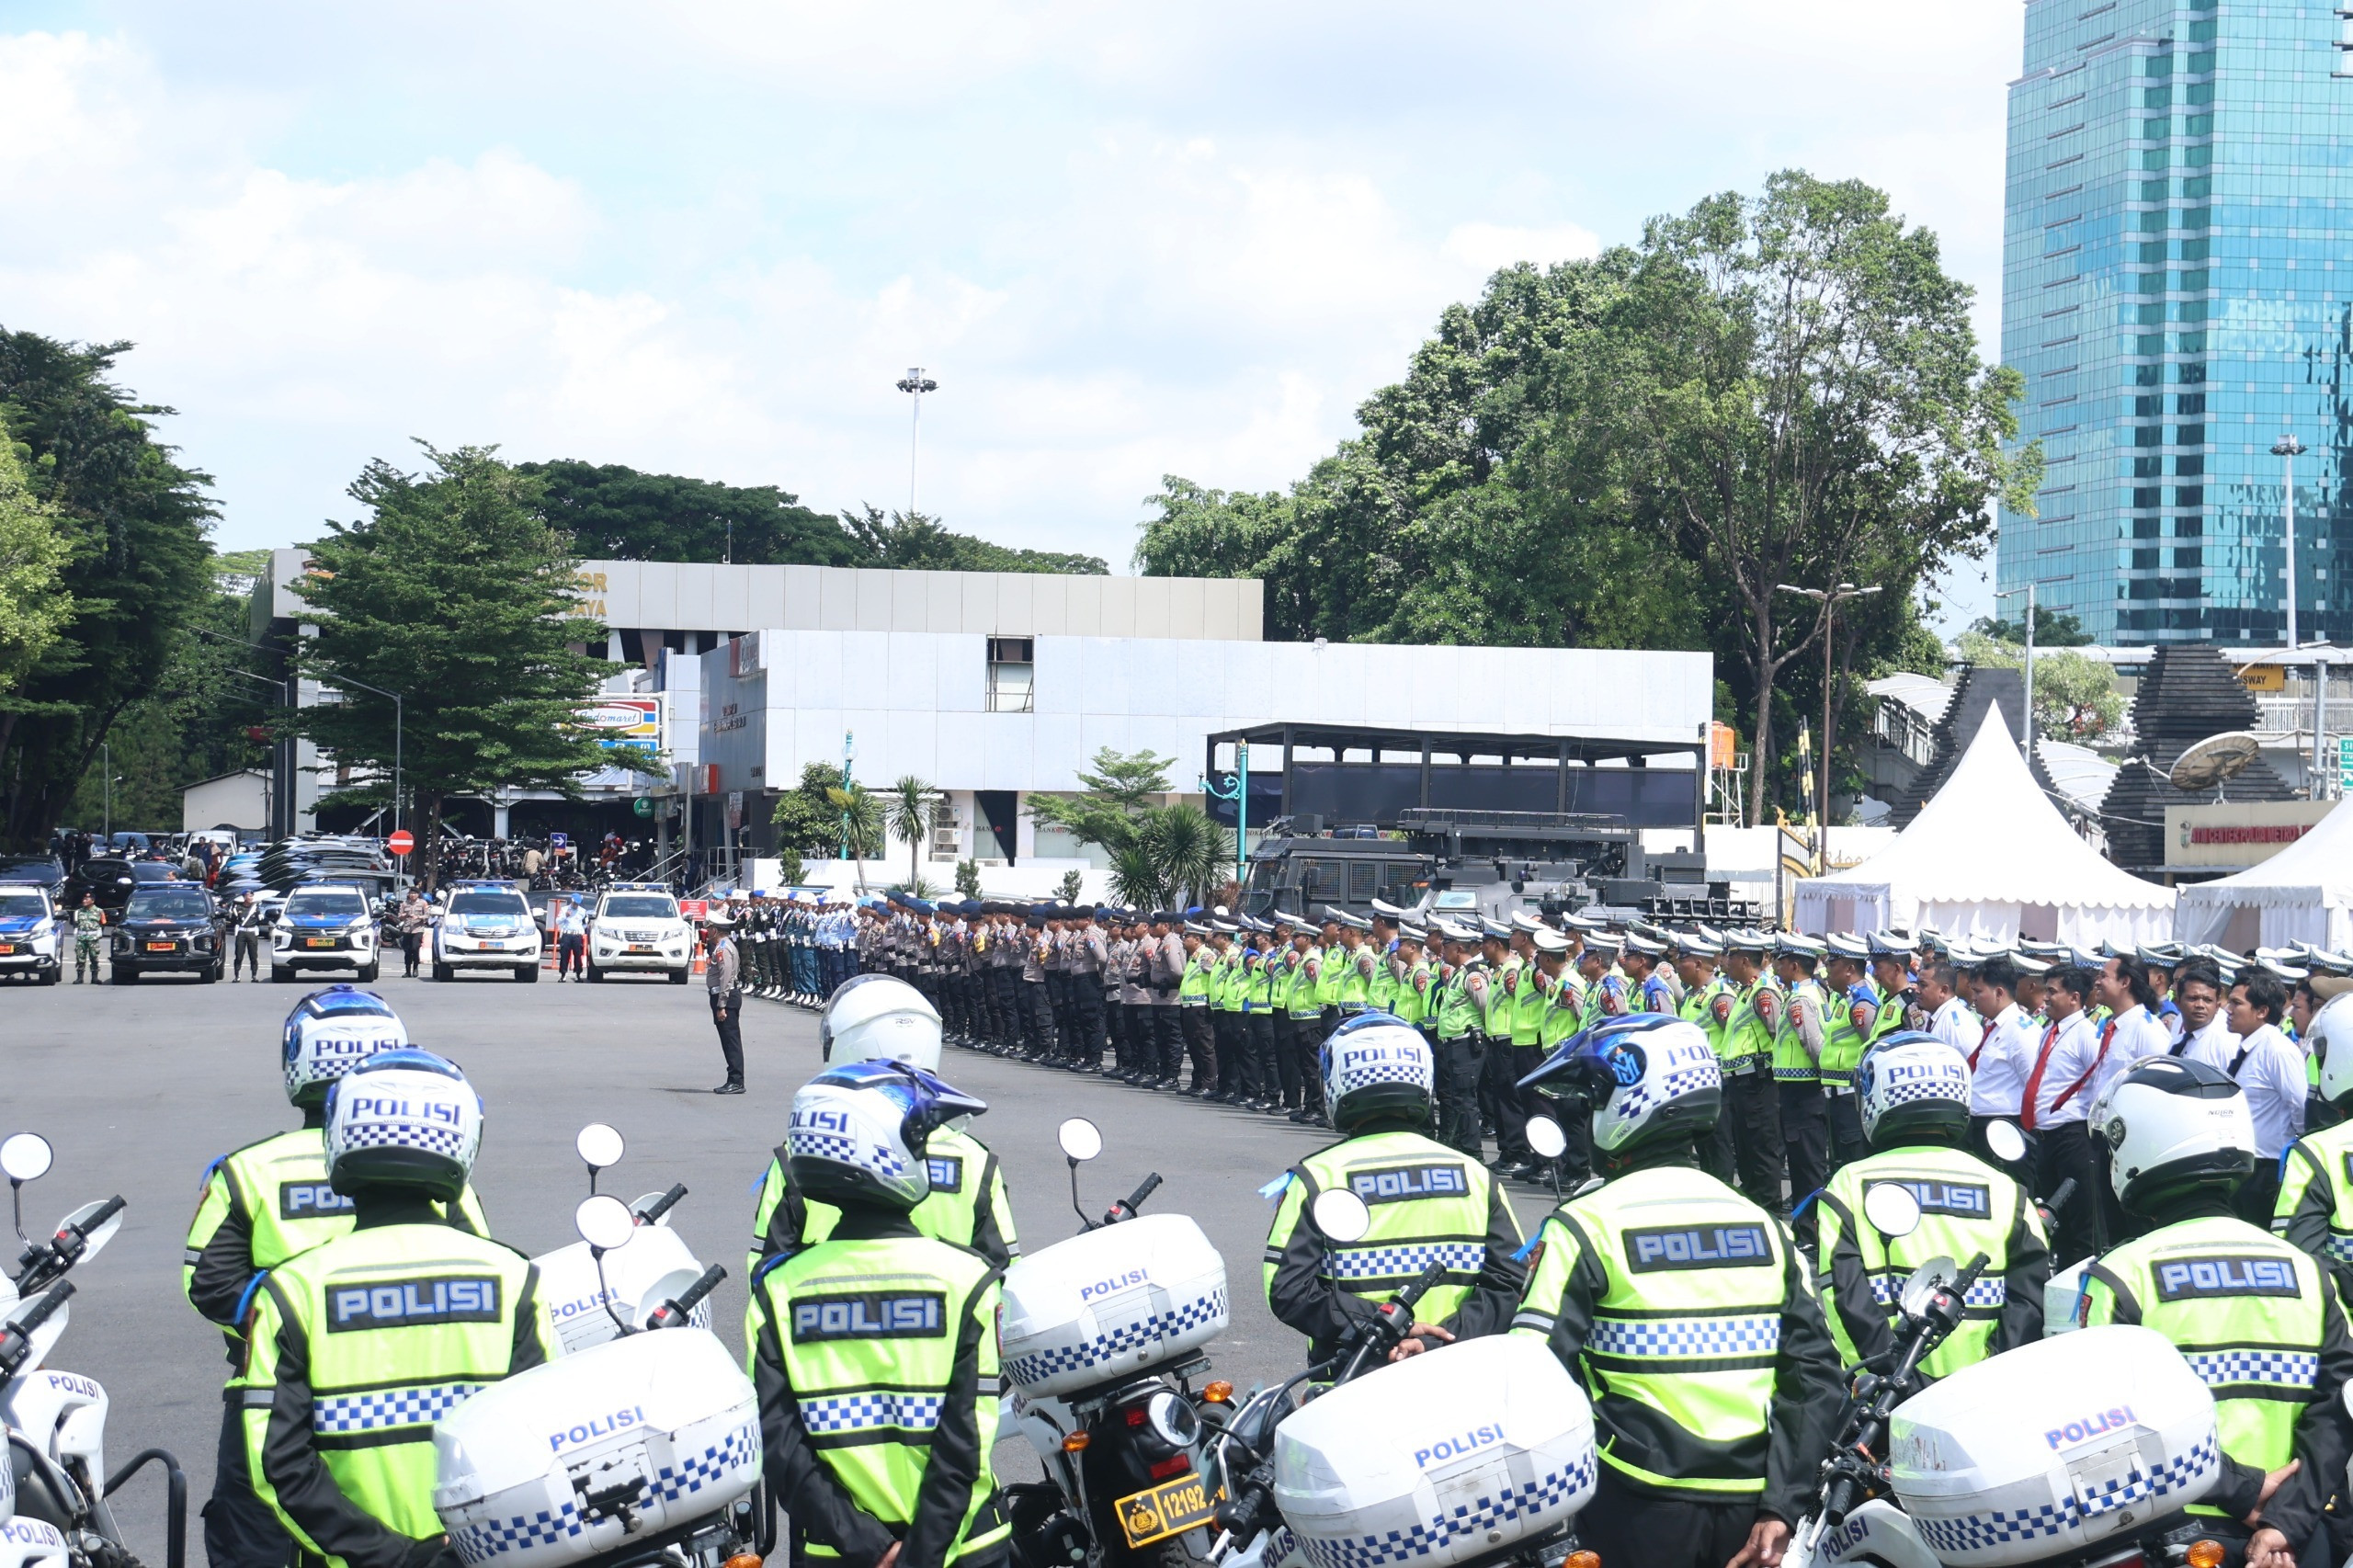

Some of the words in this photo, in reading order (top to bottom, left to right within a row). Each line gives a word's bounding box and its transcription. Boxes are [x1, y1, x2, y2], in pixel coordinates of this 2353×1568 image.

[2239, 675, 2267, 686] SWAY
[315, 1039, 400, 1057] POLISI
[1344, 1047, 1422, 1069] POLISI
[1888, 1064, 1965, 1085] POLISI
[351, 1097, 460, 1126] POLISI
[1353, 1168, 1465, 1199] POLISI
[1634, 1228, 1767, 1264] POLISI
[1080, 1267, 1149, 1301] POLISI
[2160, 1261, 2295, 1294] POLISI
[335, 1280, 495, 1323] POLISI
[795, 1297, 938, 1335] POLISI
[47, 1374, 100, 1400] POLISI
[549, 1404, 646, 1452] POLISI
[2043, 1403, 2138, 1450] POLISI
[1414, 1422, 1505, 1469] POLISI
[1163, 1484, 1208, 1519] 12192
[1, 1522, 62, 1549] POLISI
[1821, 1515, 1870, 1564] POLISI
